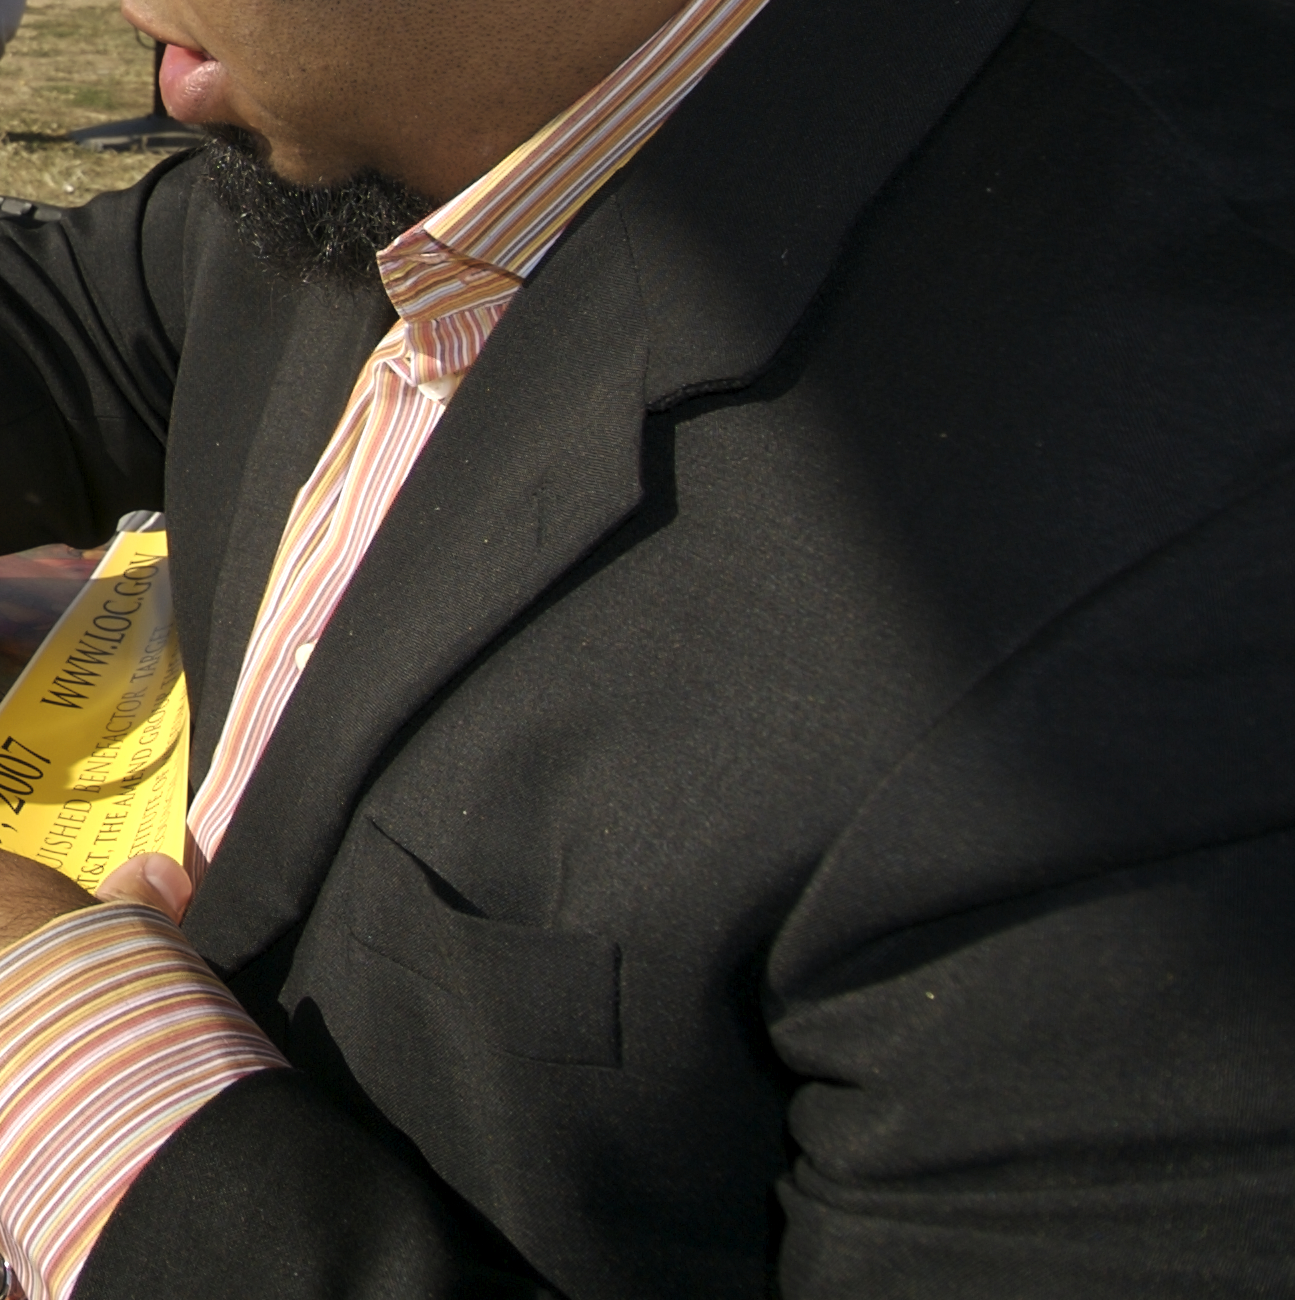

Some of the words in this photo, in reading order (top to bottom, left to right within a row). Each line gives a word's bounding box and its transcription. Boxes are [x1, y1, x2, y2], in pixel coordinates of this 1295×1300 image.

[40, 552, 163, 710] WWW.LOC.GOV
[35, 798, 93, 869] UISHED
[73, 686, 149, 794] BENEFACTOR
[130, 625, 173, 684] TARGET
[93, 812, 129, 846] THE
[113, 748, 153, 808] AMEND
[127, 792, 163, 860] STITUTE
